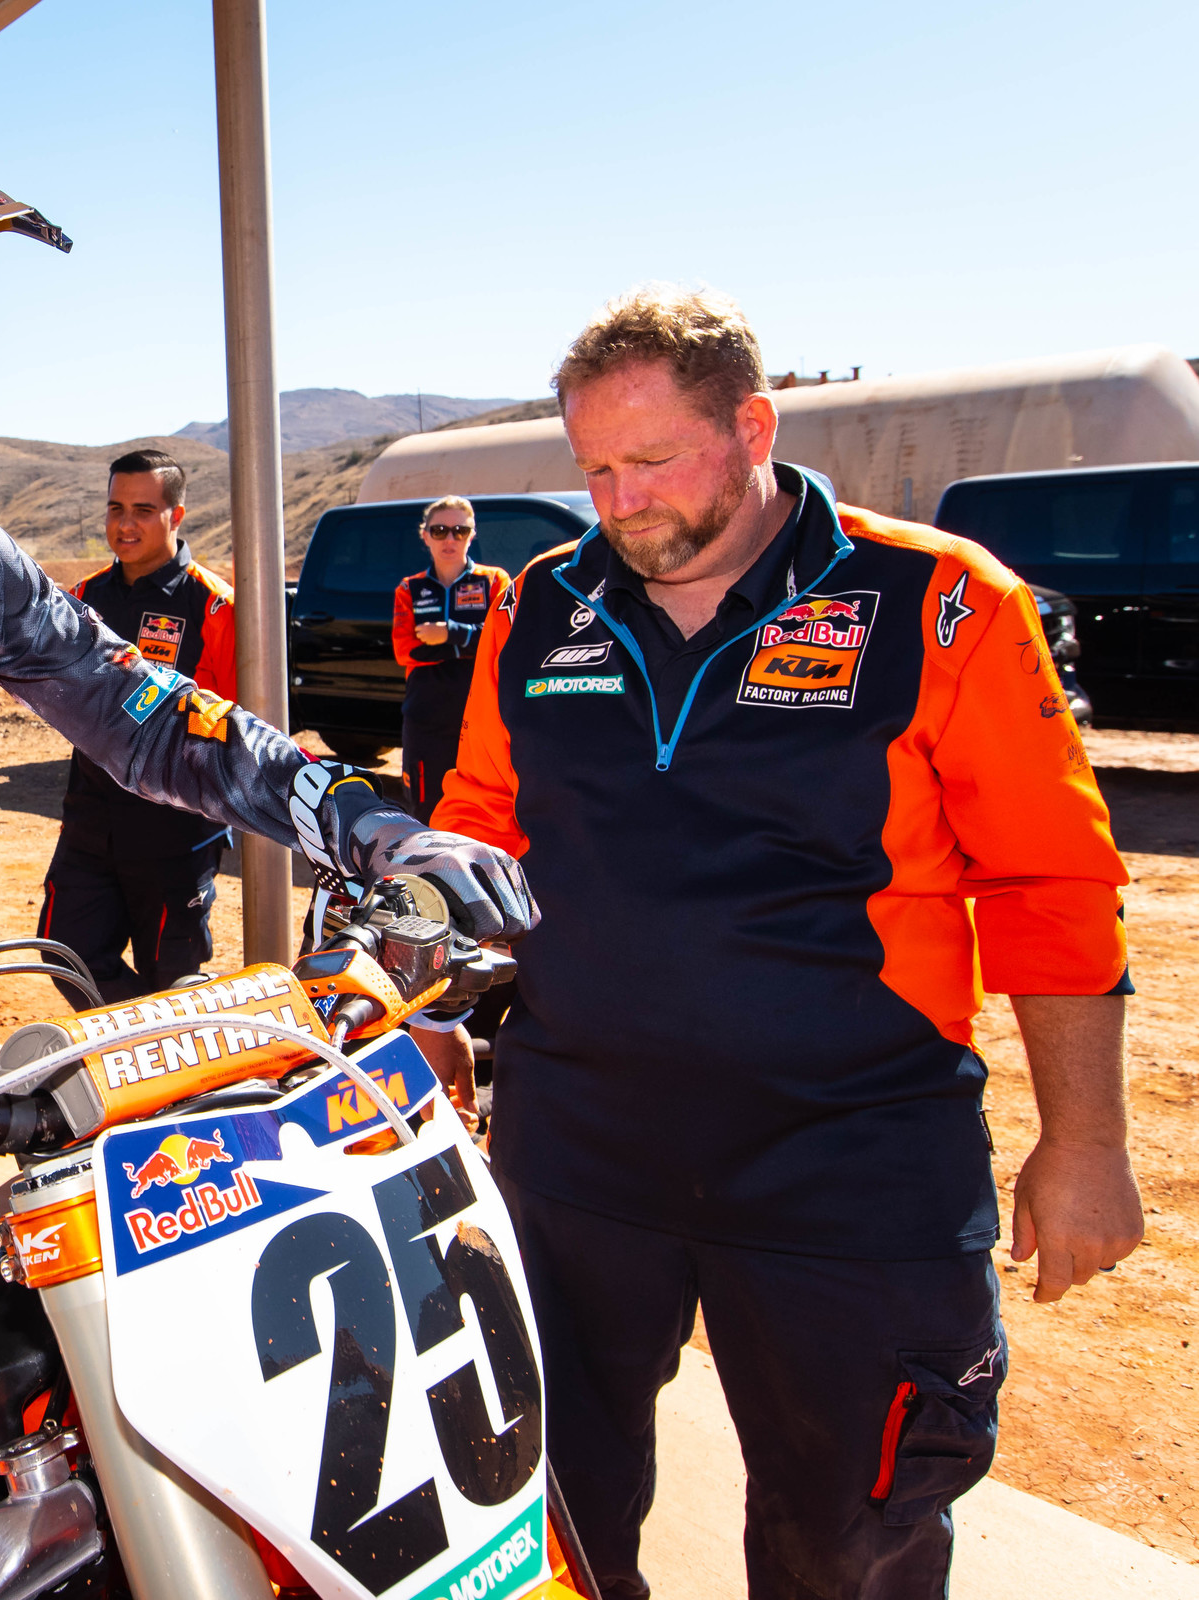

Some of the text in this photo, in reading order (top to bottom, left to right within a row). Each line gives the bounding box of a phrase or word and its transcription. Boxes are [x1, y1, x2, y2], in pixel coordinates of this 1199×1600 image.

[142, 644, 171, 657] KTM
[762, 621, 867, 648] Red Bull
[763, 654, 844, 680] KTM
[546, 676, 623, 693] MOTOREX
[744, 685, 849, 703] FACTORY RACING
[76, 972, 291, 1040] RENTHAL
[101, 1004, 313, 1090] RENTHAL
[327, 1067, 409, 1133] KTM
[127, 1171, 261, 1254] Red Bull
[251, 1143, 543, 1597] 25
[449, 1521, 539, 1600] MOTOREX
